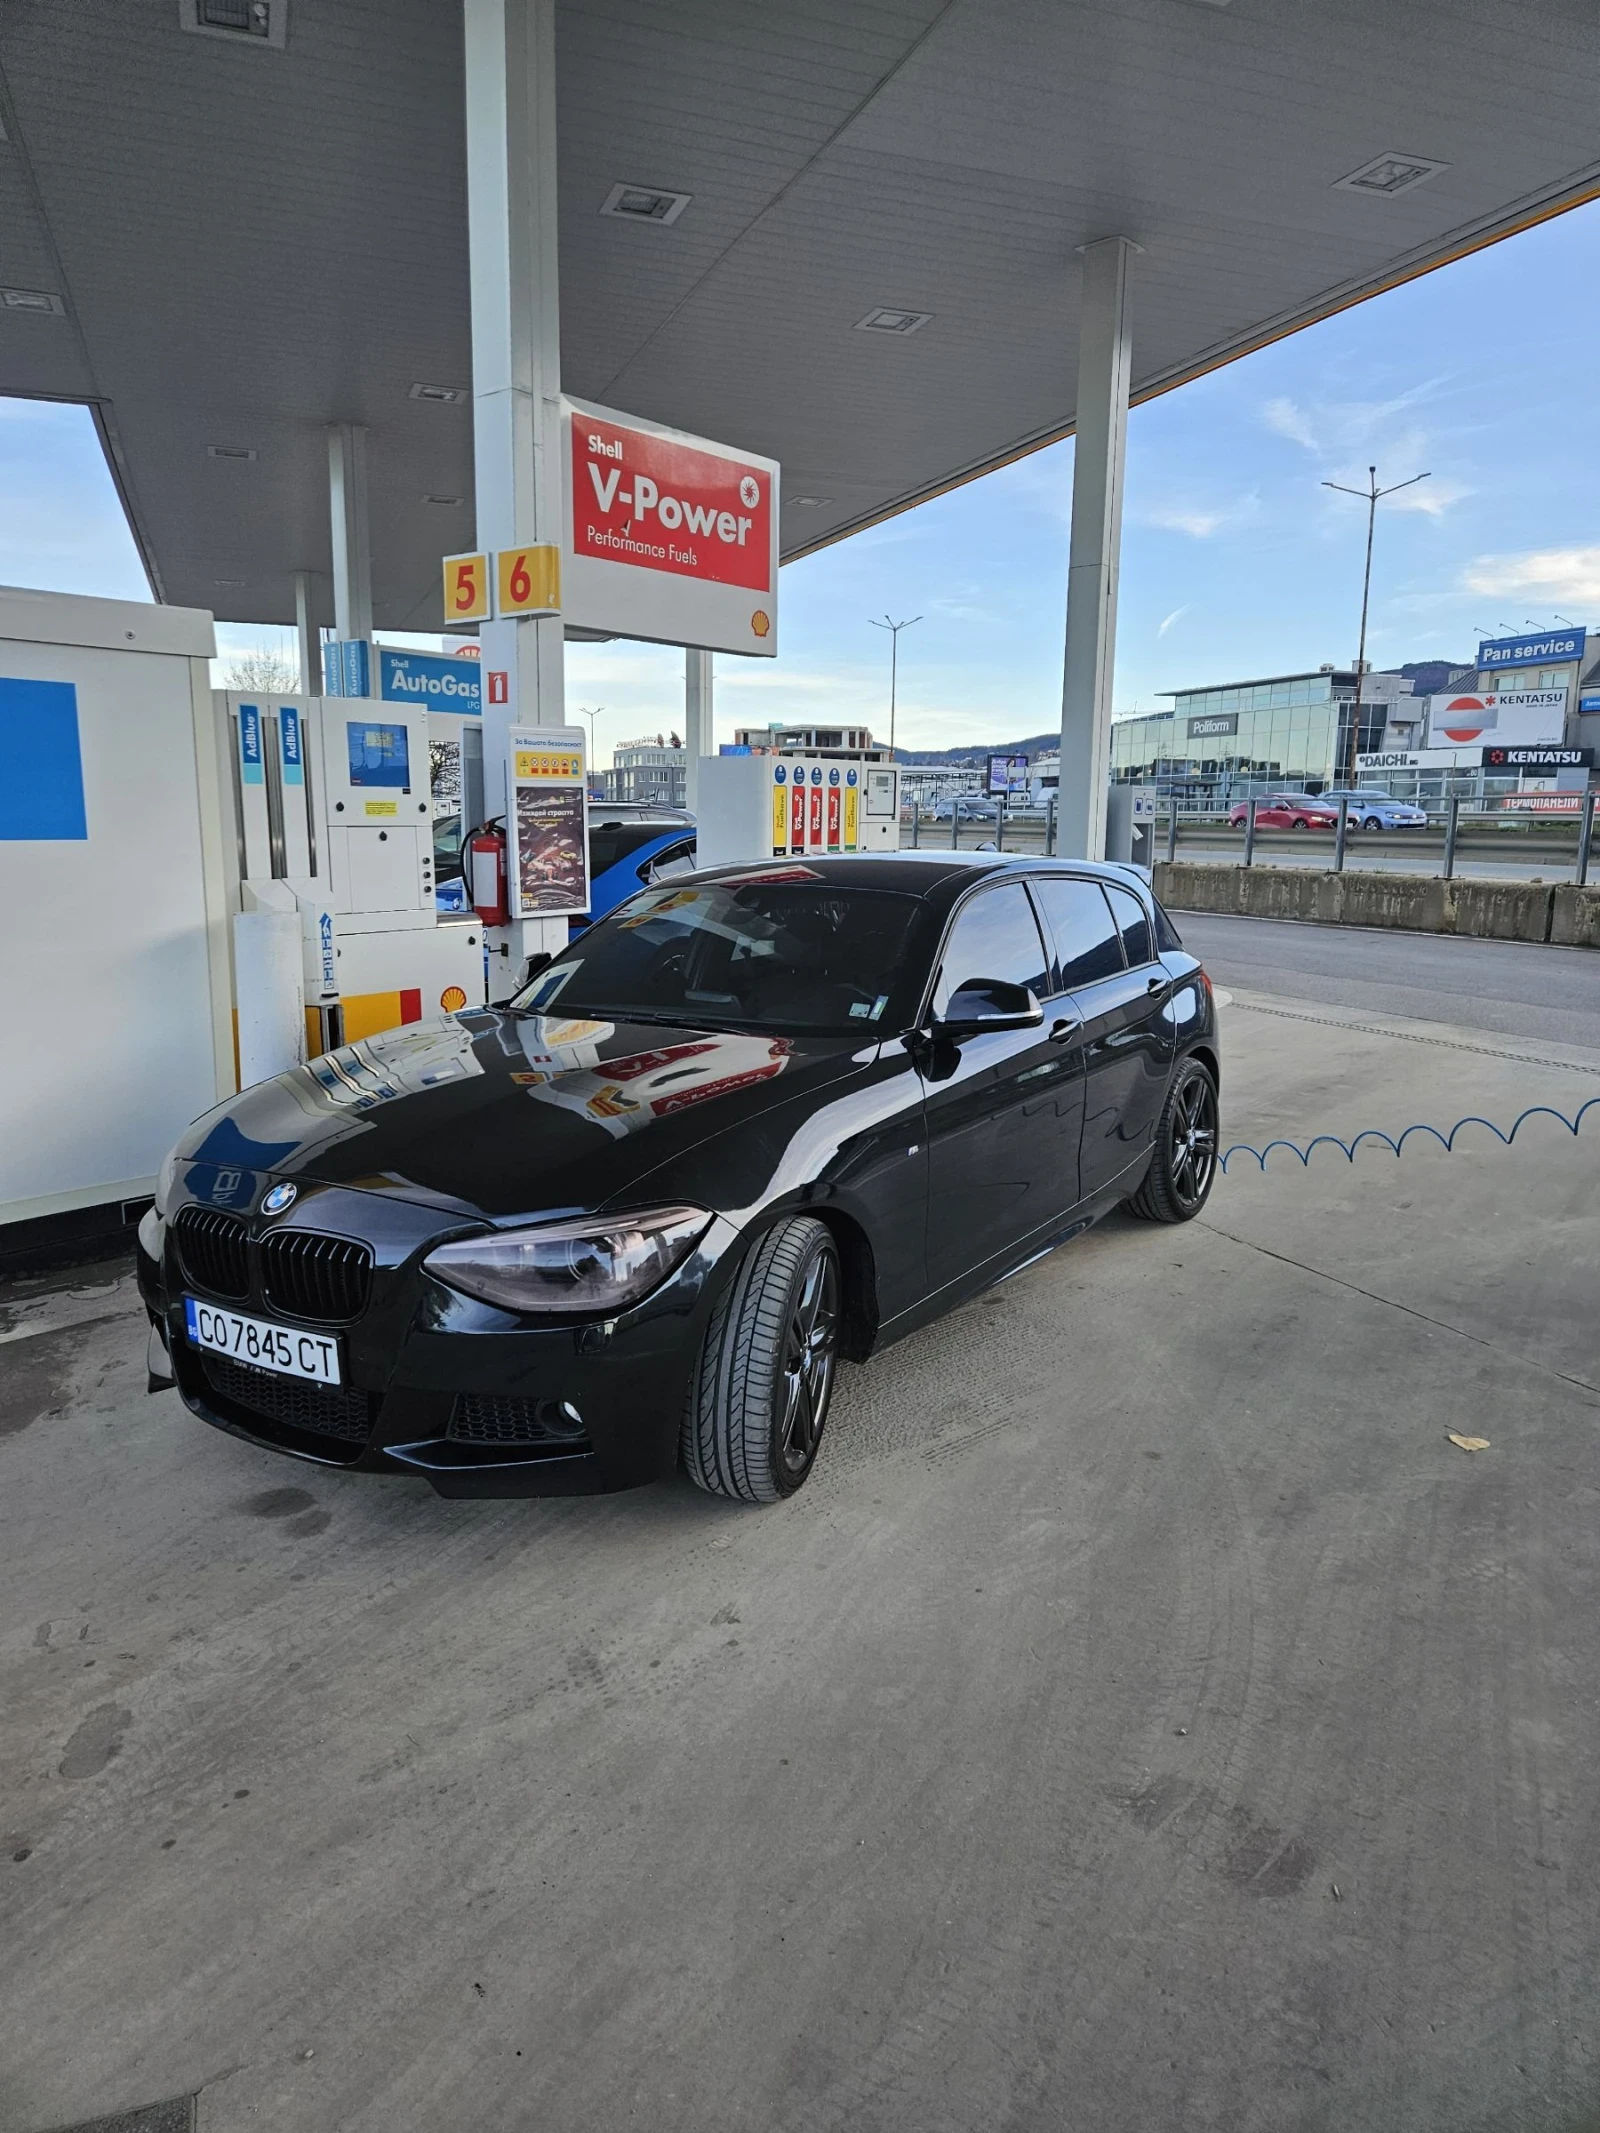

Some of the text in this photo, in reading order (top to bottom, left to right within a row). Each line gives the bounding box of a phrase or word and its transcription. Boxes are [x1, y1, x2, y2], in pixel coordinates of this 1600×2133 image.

[588, 434, 622, 460] Shell
[588, 461, 752, 546] V-Power
[588, 525, 697, 566] Performance Fuels
[456, 564, 476, 610] 5
[510, 555, 531, 603] 6
[1483, 640, 1575, 662] Pan service
[390, 659, 408, 668] Shell
[392, 670, 480, 698] AutoGas
[467, 701, 480, 710] LPG
[1500, 694, 1562, 704] KENTATSU
[245, 715, 258, 758] AdBlue
[285, 717, 297, 758] AdBlue
[1194, 720, 1229, 734] Poliform
[1508, 751, 1582, 763] KENTATSU
[1506, 798, 1579, 808] ТЕРМОПАНЕЛИ
[188, 1325, 198, 1337] BG
